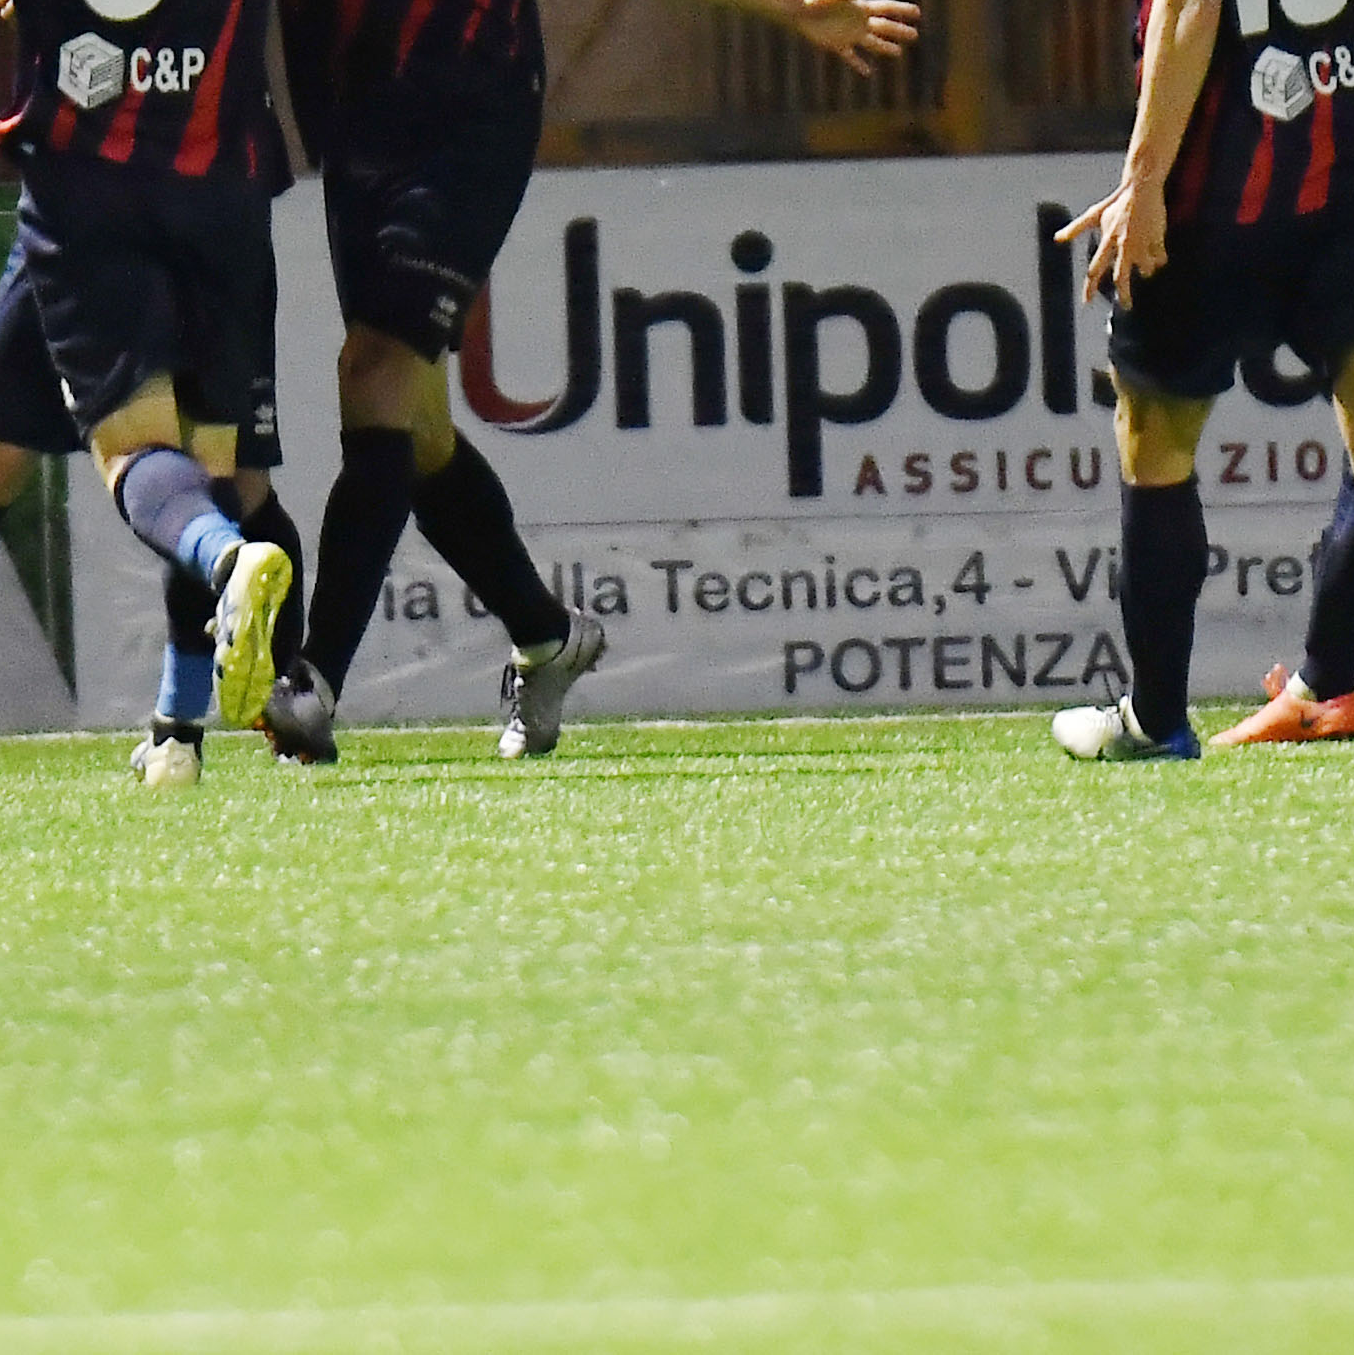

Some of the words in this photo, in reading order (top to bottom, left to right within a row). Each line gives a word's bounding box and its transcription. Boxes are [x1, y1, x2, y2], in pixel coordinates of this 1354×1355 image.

[130, 47, 205, 93] C&P
[383, 573, 440, 622] ia
[784, 630, 1130, 694] POTENZA
